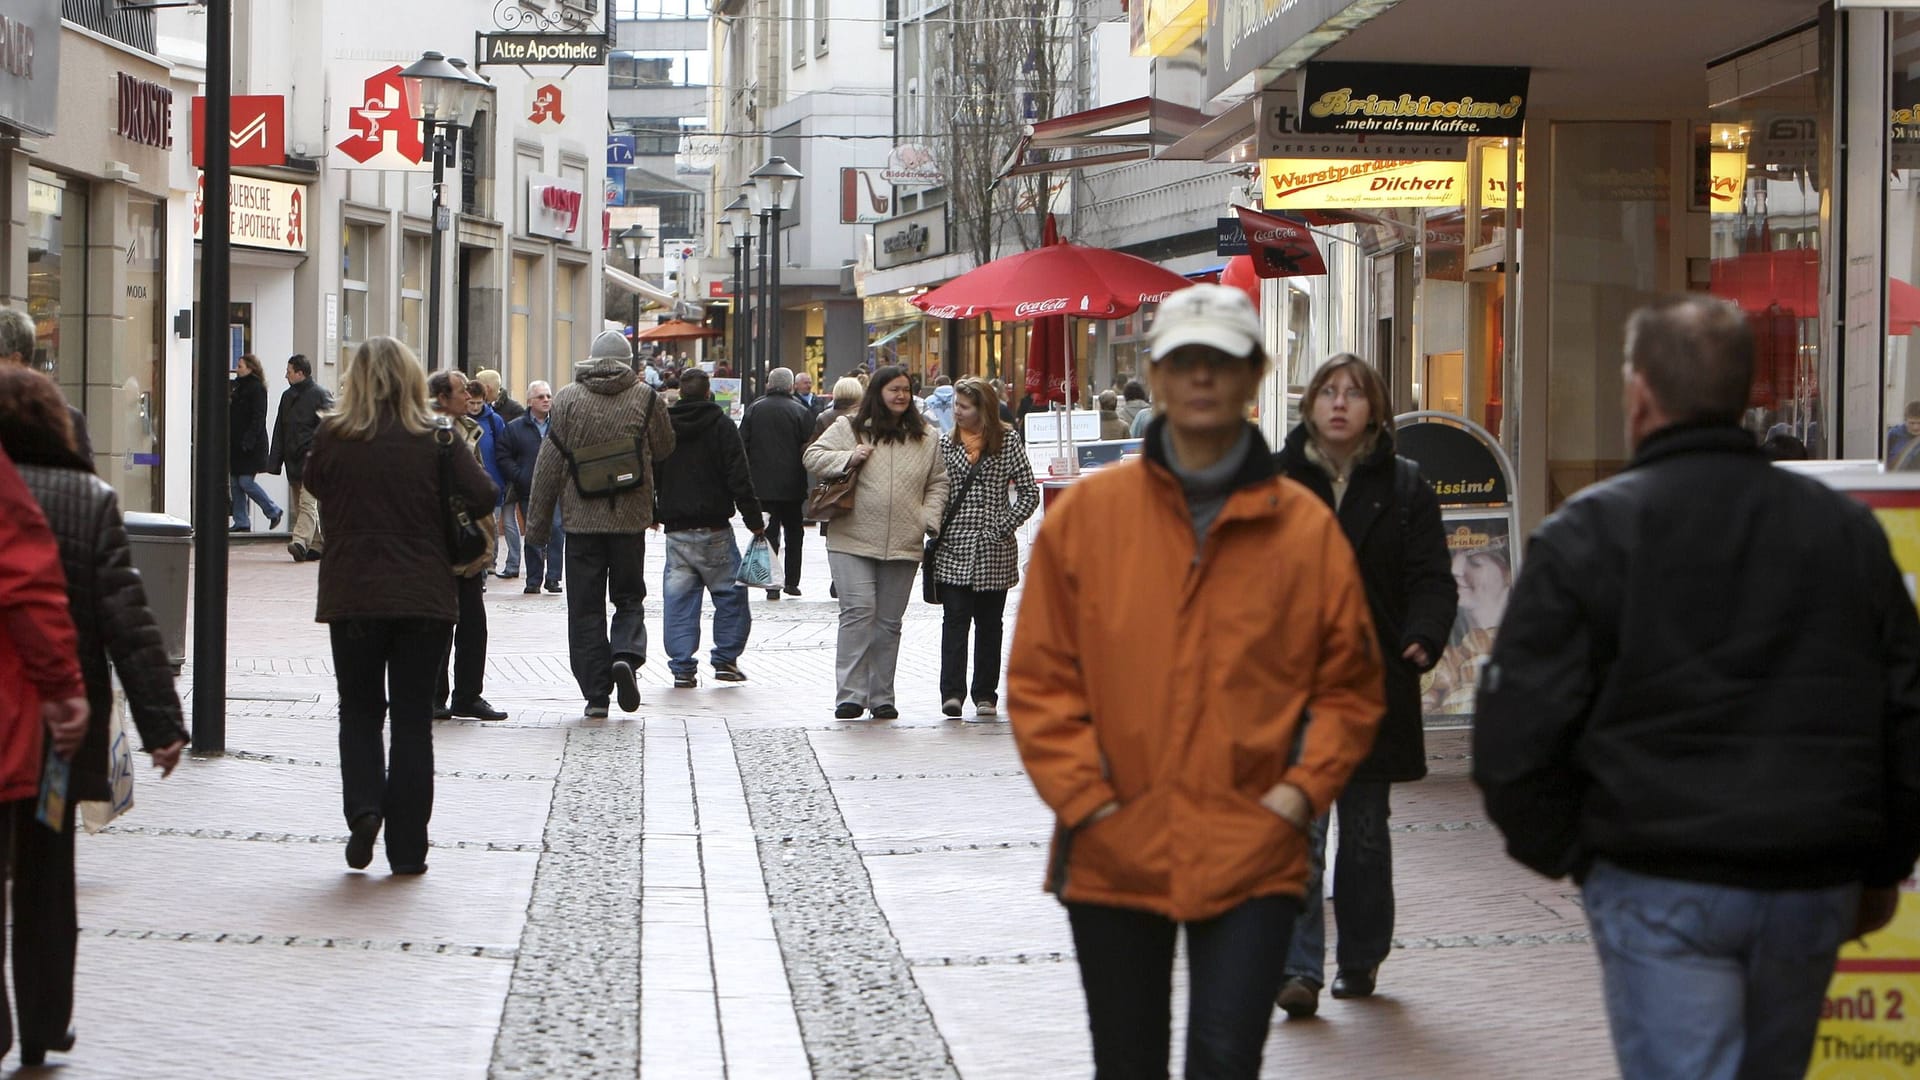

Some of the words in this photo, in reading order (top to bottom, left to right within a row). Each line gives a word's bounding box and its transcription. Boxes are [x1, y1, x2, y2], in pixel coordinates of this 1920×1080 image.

[492, 39, 525, 59] Alte
[526, 39, 598, 61] Apotheke
[116, 71, 173, 149] DROSTE
[1383, 118, 1403, 131] als
[1404, 121, 1431, 132] nur
[1431, 119, 1480, 133] Kaffee.
[1272, 143, 1453, 156] PERSONALSERVICE
[1369, 176, 1455, 192] Dilchert
[229, 183, 272, 212] BUERSCHE
[238, 211, 281, 241] APOTHEKE
[126, 284, 148, 299] MODA
[1884, 988, 1905, 1021] 2
